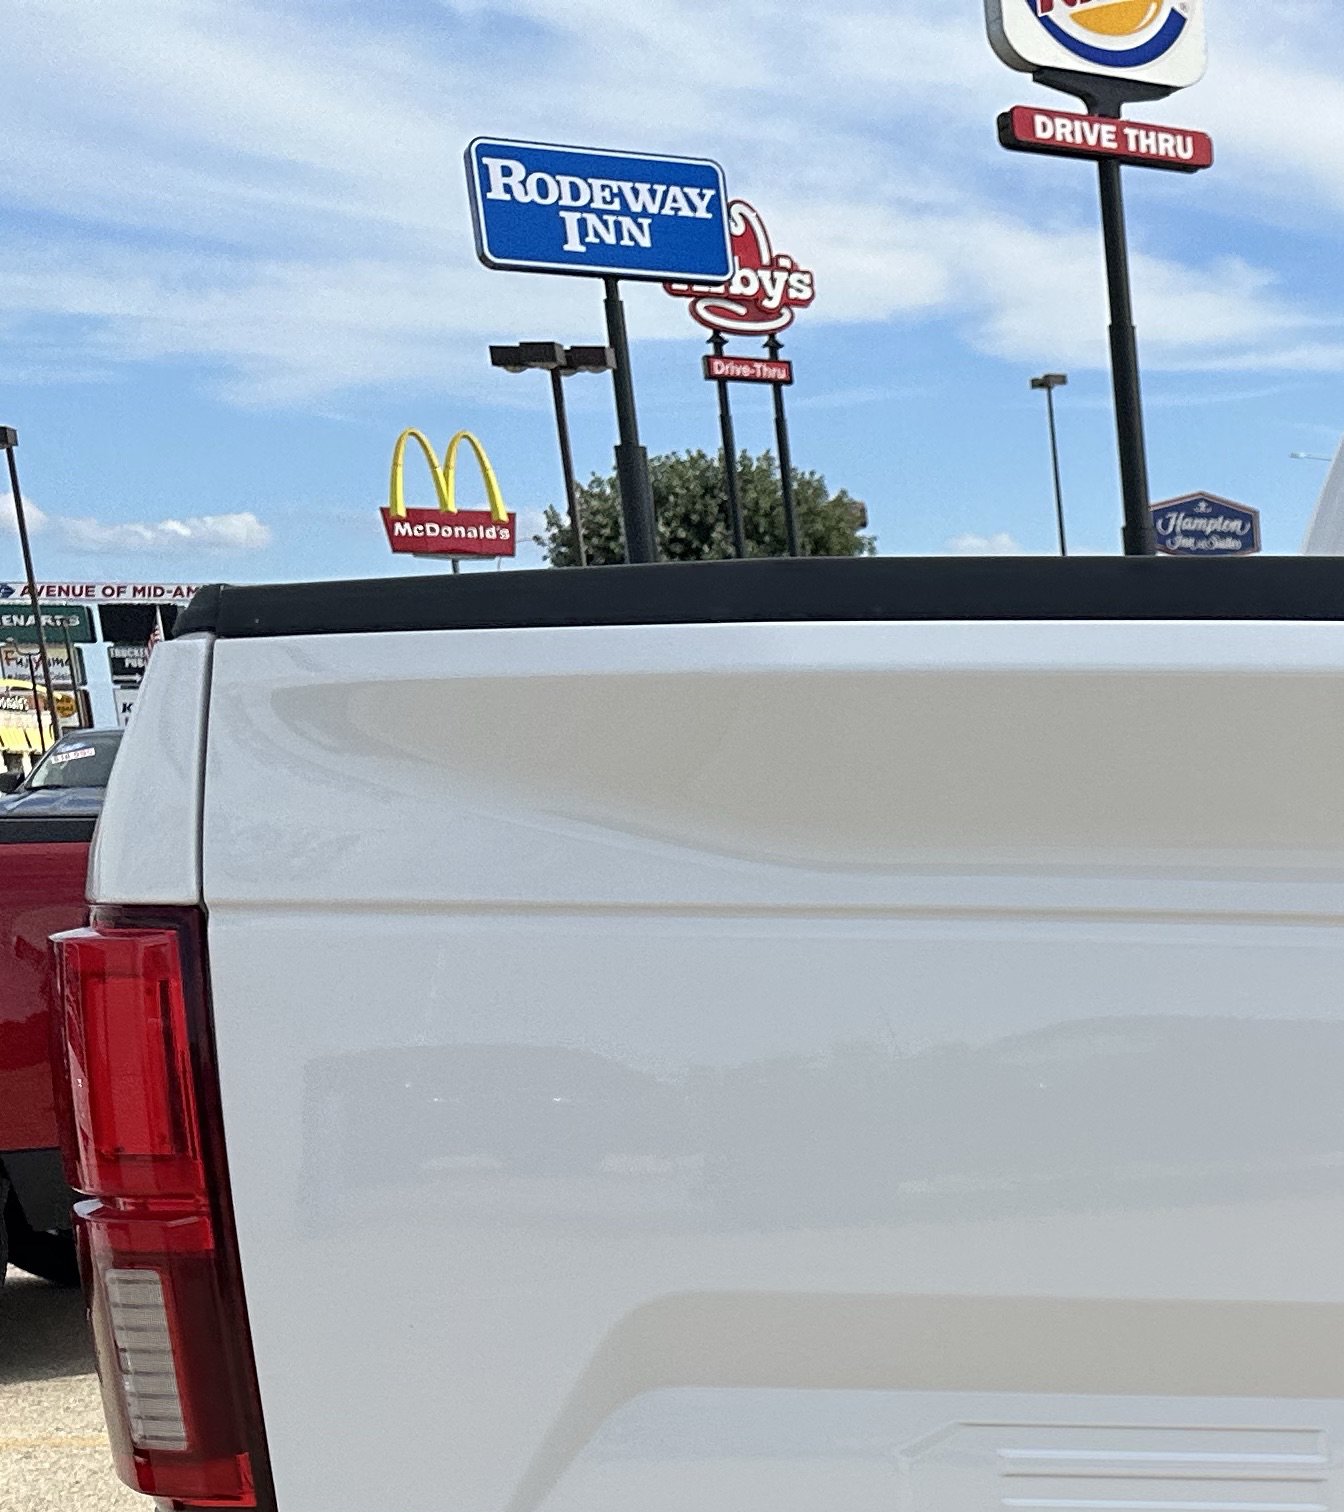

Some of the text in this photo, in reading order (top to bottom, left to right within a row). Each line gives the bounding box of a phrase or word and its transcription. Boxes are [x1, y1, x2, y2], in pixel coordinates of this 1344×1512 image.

[1033, 114, 1194, 160] DRIVE THRU
[482, 157, 715, 219] RODEWAY
[559, 211, 652, 253] INN
[671, 255, 814, 309] by's
[393, 521, 510, 540] McDonald's
[1156, 511, 1251, 536] Hampton
[20, 585, 96, 597] AVENUE
[102, 585, 127, 598] OF
